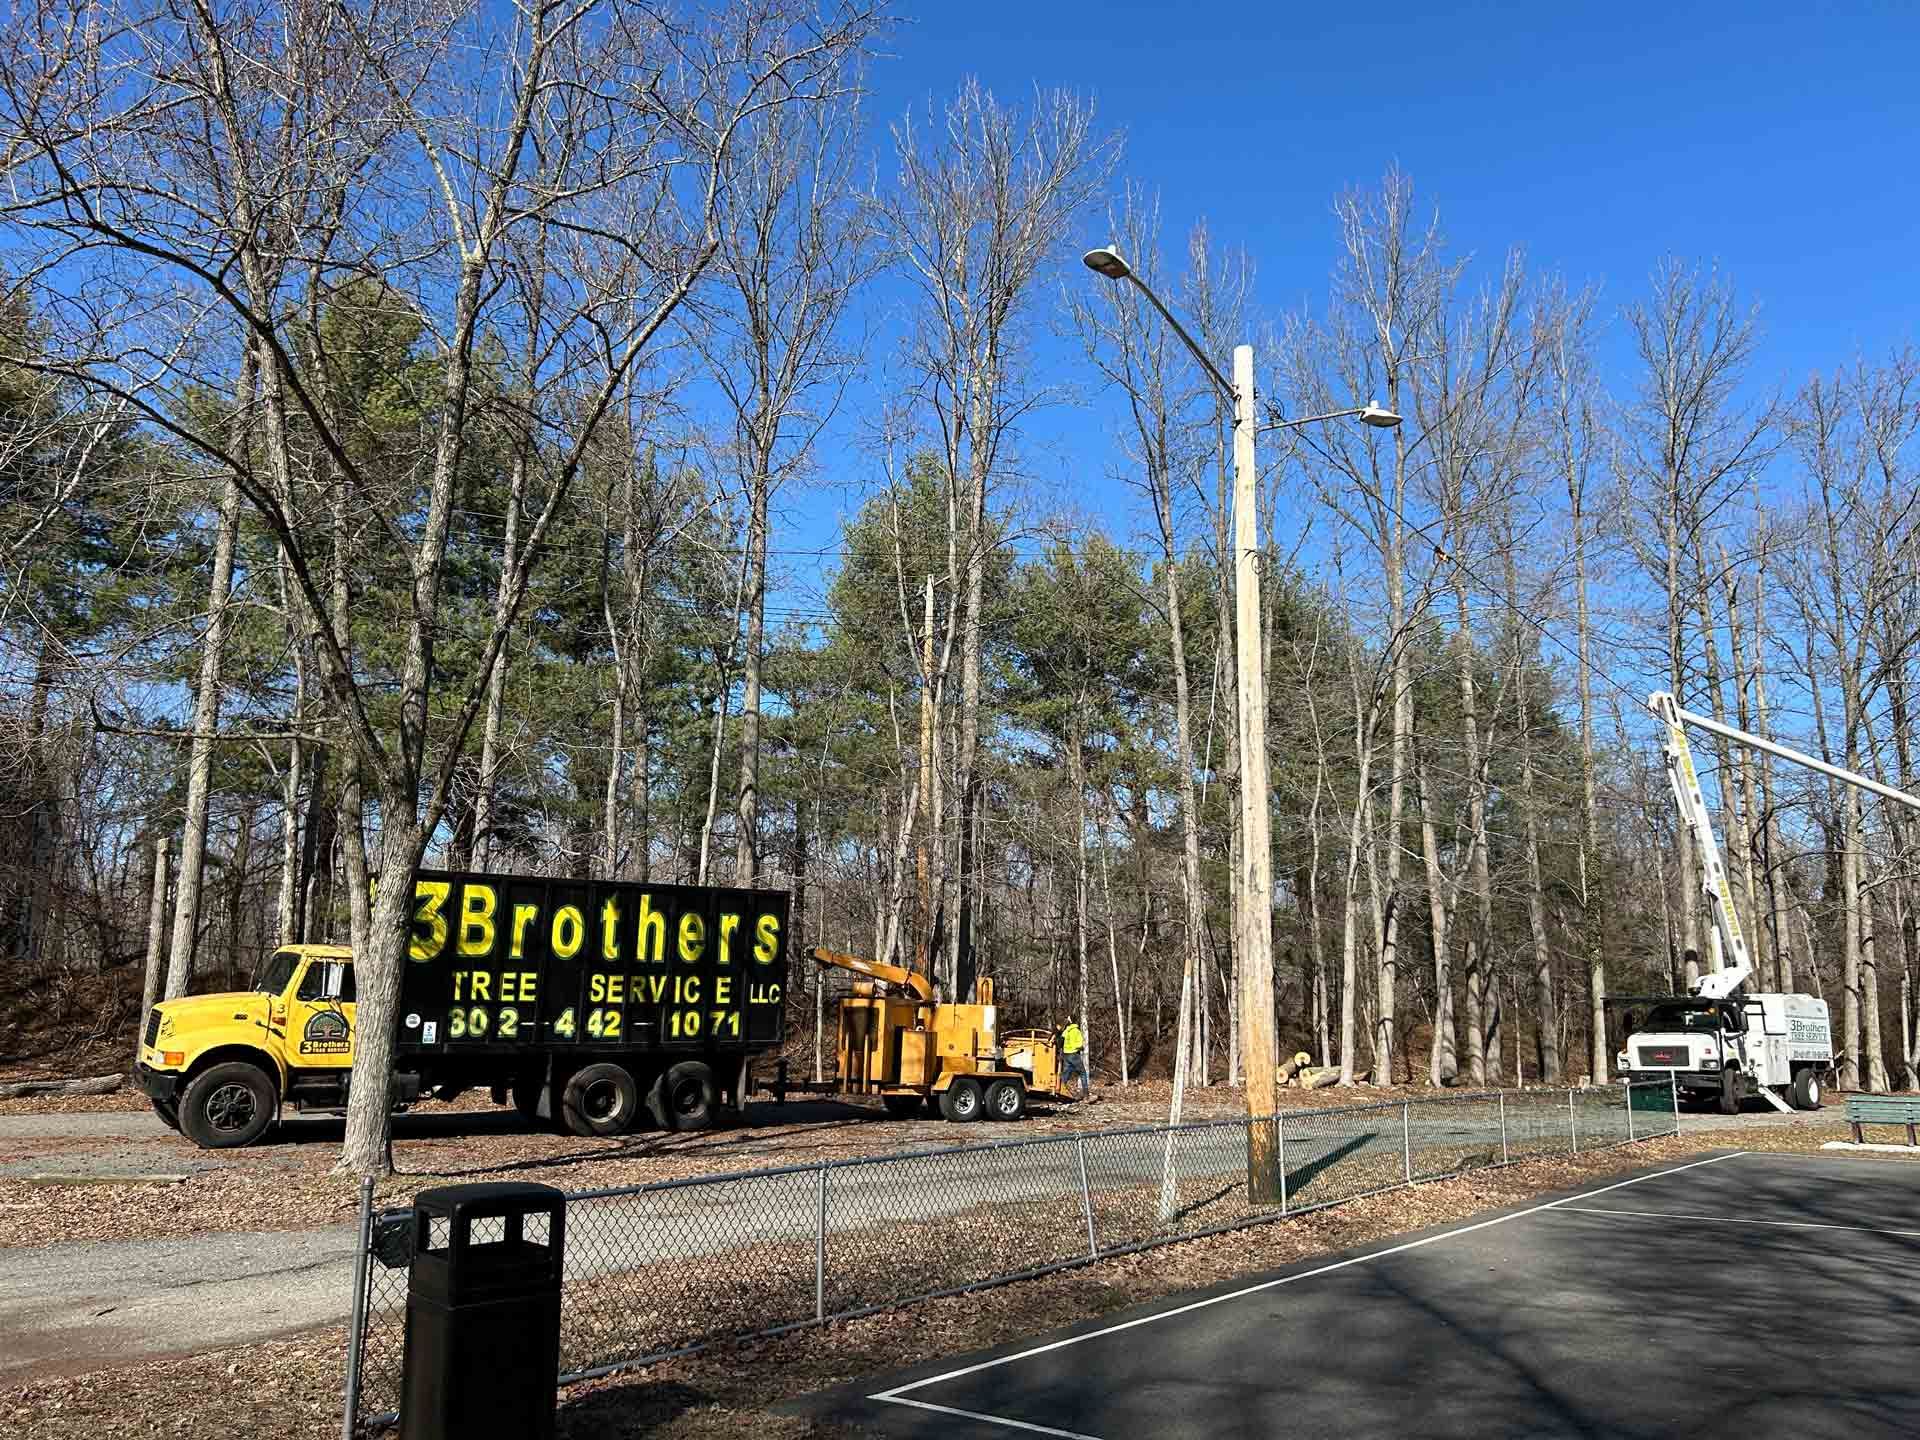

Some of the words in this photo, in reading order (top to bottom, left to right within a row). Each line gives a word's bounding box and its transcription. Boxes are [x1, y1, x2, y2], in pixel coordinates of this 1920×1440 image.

[453, 971, 537, 1001] TREE
[590, 974, 731, 1004] SERVICE
[749, 983, 781, 1004] LLC
[302, 1041, 313, 1053] 3
